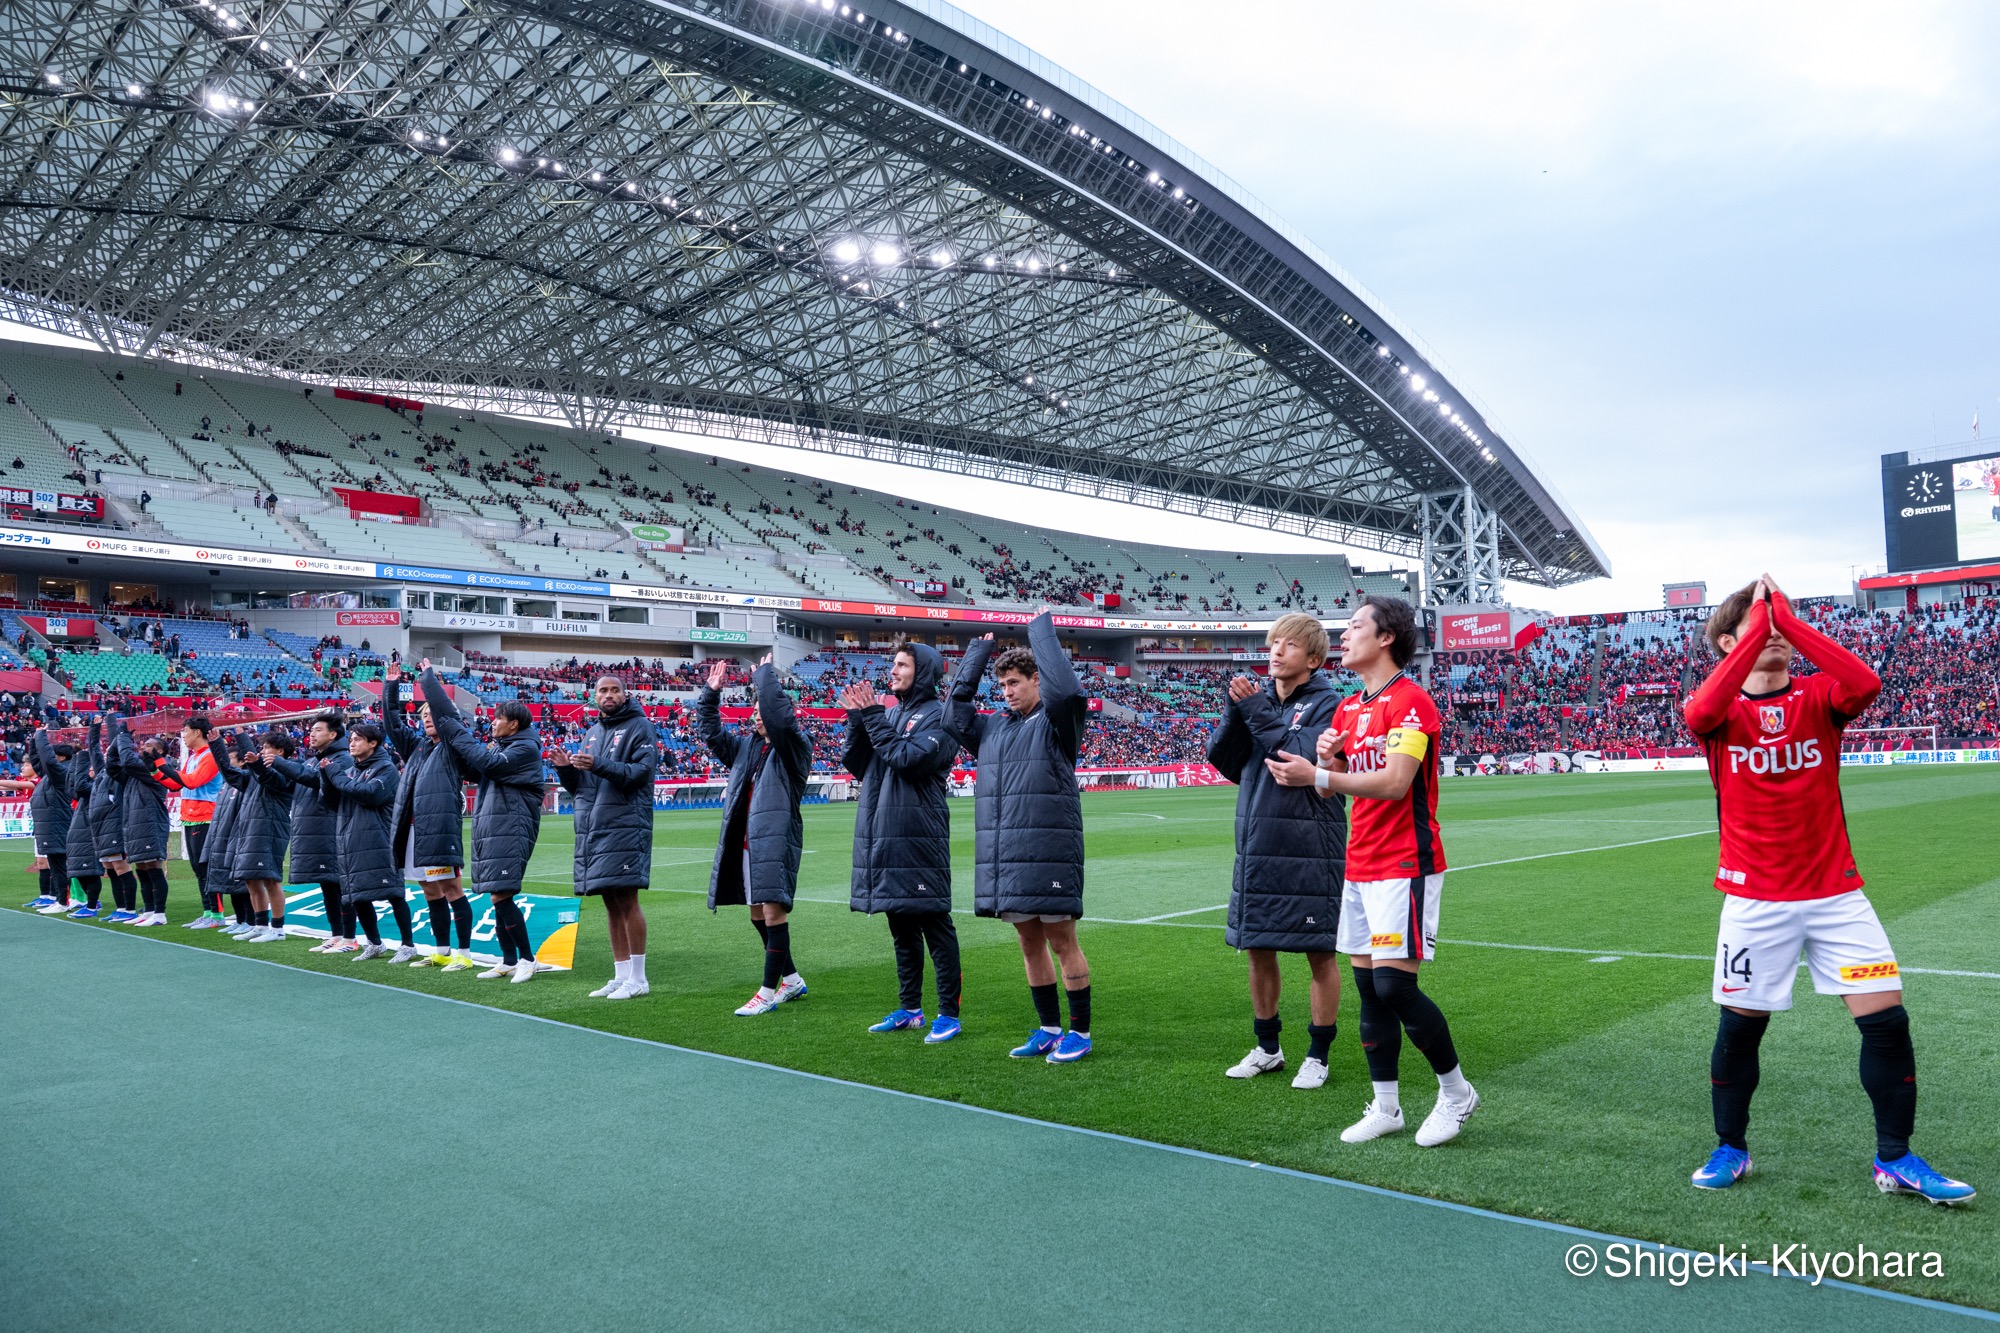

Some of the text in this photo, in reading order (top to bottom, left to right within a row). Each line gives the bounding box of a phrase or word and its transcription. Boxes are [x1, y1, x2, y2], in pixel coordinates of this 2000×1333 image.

[36, 493, 54, 502] 502
[1915, 504, 1951, 515] RHYTHM
[102, 542, 127, 551] MUFG
[210, 552, 233, 561] MUFG
[308, 561, 329, 569] MUFG
[818, 600, 842, 611] POLUS
[874, 605, 897, 615] POLUS
[927, 608, 949, 618] POLUS
[48, 618, 67, 627] 303
[459, 617, 515, 629] クリーン工房
[1451, 616, 1479, 627] COME
[1463, 623, 1478, 631] ON
[546, 622, 588, 633] FUJIFILM
[1471, 623, 1502, 636] REDS!
[399, 684, 413, 693] 203
[1387, 732, 1402, 748] C
[1728, 738, 1823, 774] POLUS
[1723, 943, 1753, 983] 14
[1850, 964, 1899, 980] DHL
